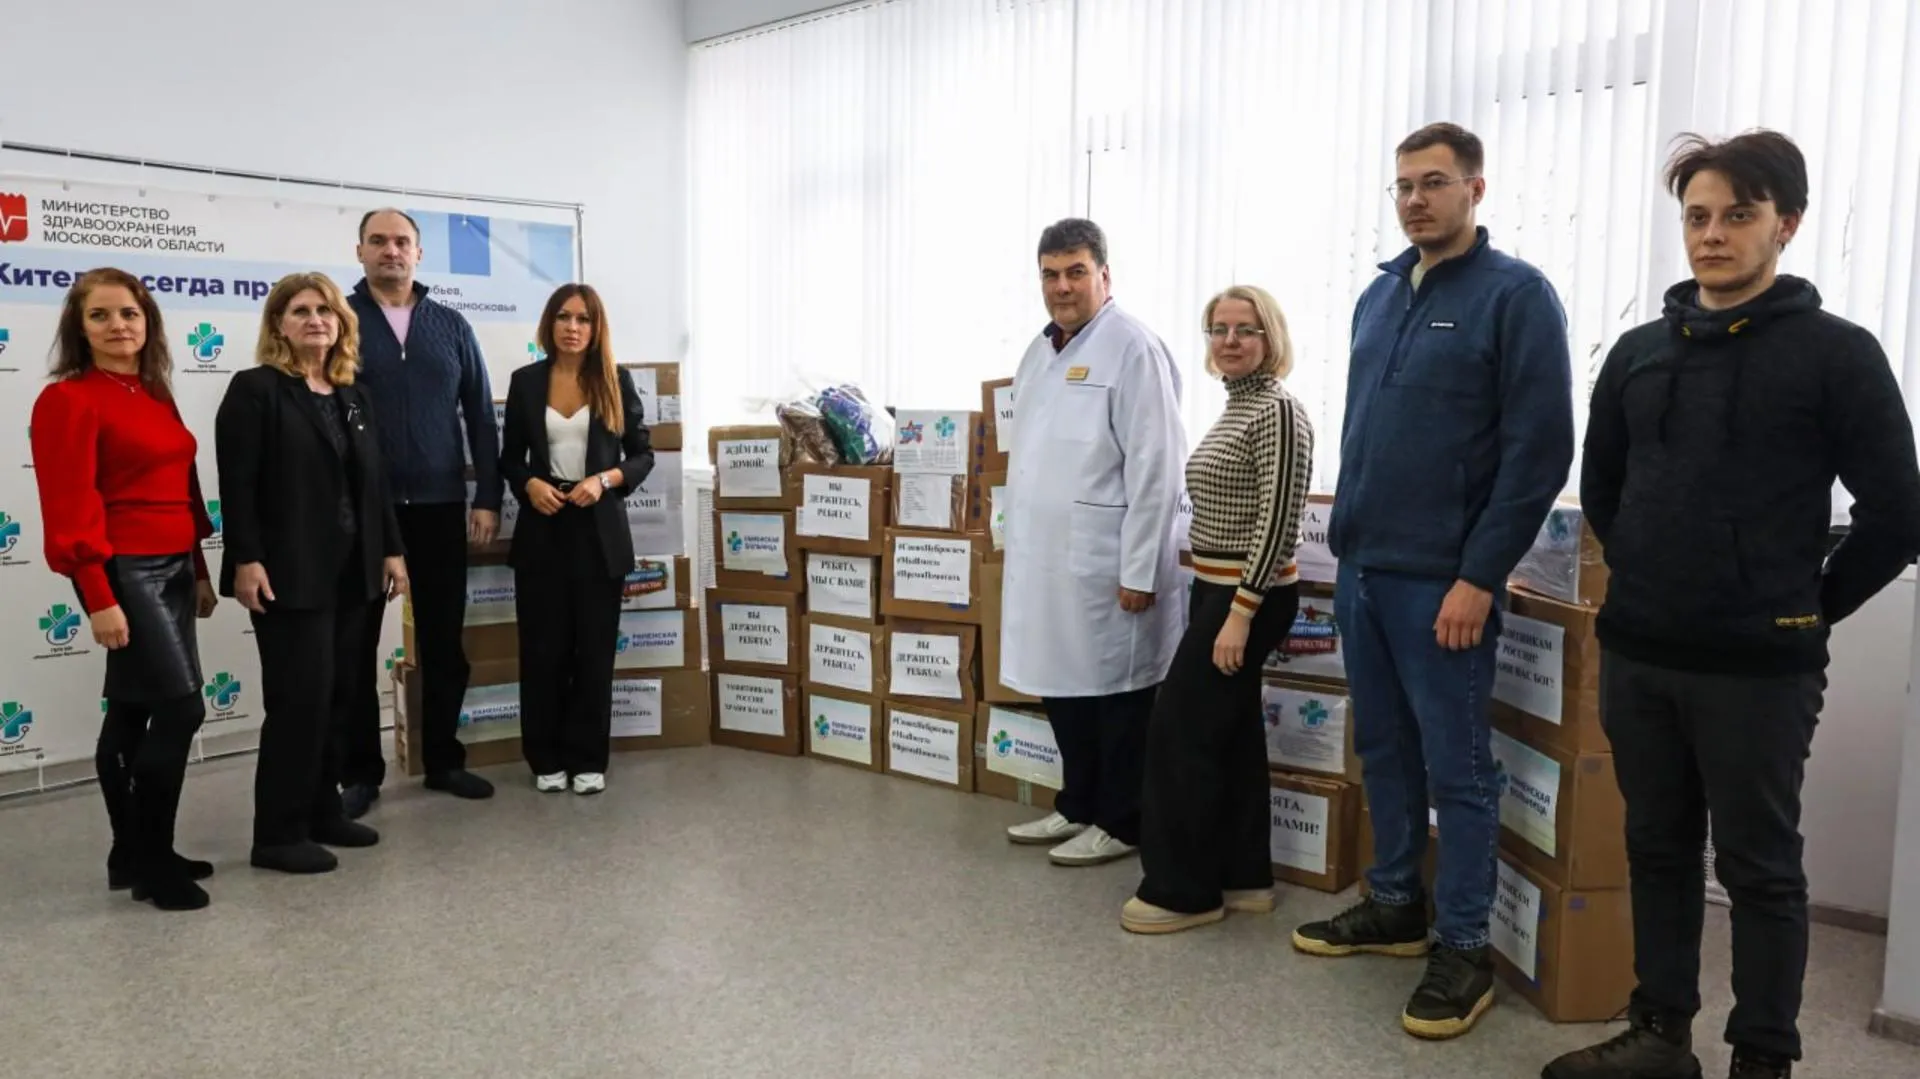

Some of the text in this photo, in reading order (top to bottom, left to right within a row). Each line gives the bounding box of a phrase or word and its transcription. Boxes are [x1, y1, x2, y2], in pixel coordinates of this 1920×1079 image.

[41, 199, 170, 220] МИНИСТЕРСТВО
[42, 214, 197, 237] ЗДРАВООХРАНЕНИЯ
[43, 230, 225, 253] МОСКОВСКОЙ ОБЛАСТИ
[142, 274, 225, 298] сегда
[828, 482, 842, 491] ВЫ
[747, 611, 760, 619] ВЫ
[833, 633, 846, 643] ВЫ
[916, 640, 930, 650] ВЫ
[1272, 796, 1305, 814] ЯТА,
[1273, 815, 1320, 835] ВАМИ!
